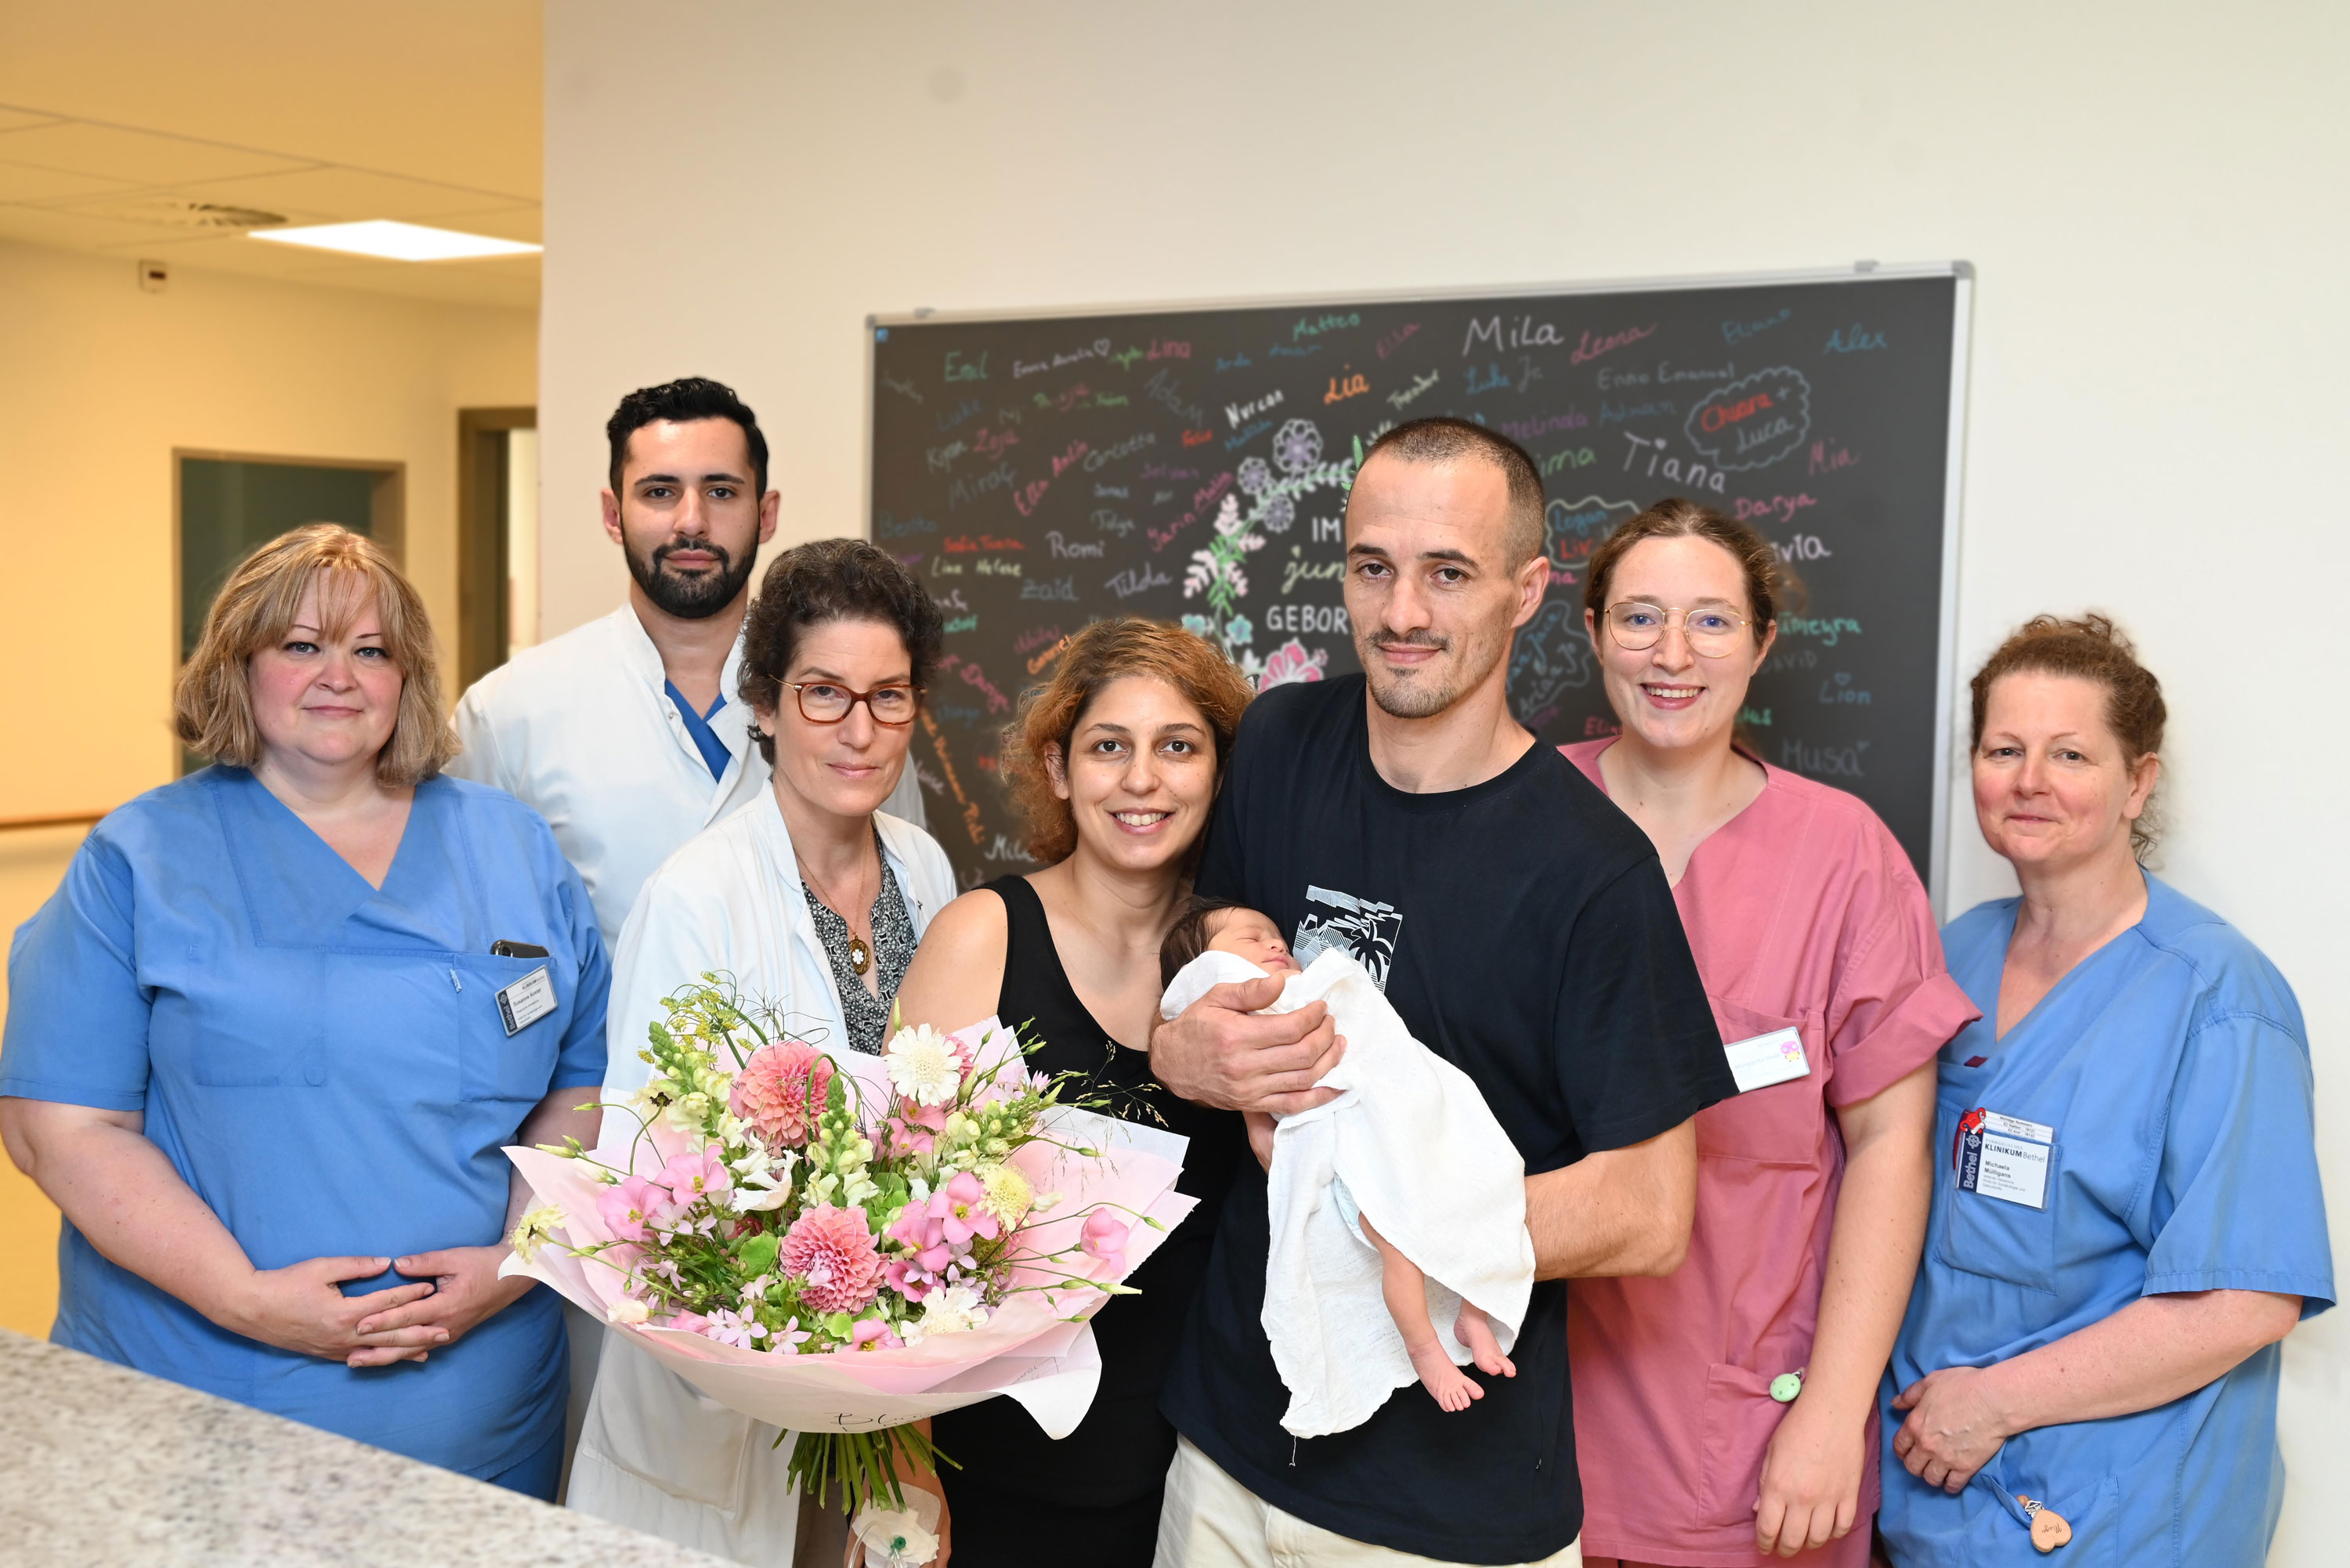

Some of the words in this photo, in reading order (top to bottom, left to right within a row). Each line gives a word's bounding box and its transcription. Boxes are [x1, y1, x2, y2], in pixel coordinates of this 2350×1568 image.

[1293, 313, 1361, 342] Matteo
[1462, 315, 1566, 358] Mila
[1824, 323, 1889, 356] Alex
[1147, 338, 1191, 361] Lina
[1324, 363, 1371, 406] Lia
[1500, 404, 1590, 441] Melinda
[1701, 392, 1774, 432] Chiara
[1735, 417, 1797, 455] Luca
[1623, 431, 1726, 494] Tiana
[1808, 435, 1863, 477] Mia
[1734, 491, 1819, 523] Darya
[1045, 529, 1106, 559] Romi
[1311, 515, 1342, 544] IM
[1019, 573, 1081, 603] Zaid
[1103, 561, 1173, 600] Tilda
[1280, 544, 1346, 596] jun
[1266, 604, 1350, 636] GEBOR
[1818, 678, 1872, 705] Lion
[1781, 739, 1865, 779] Musa
[1962, 1151, 1979, 1190] Bethel
[1984, 1160, 2011, 1172] Michaela
